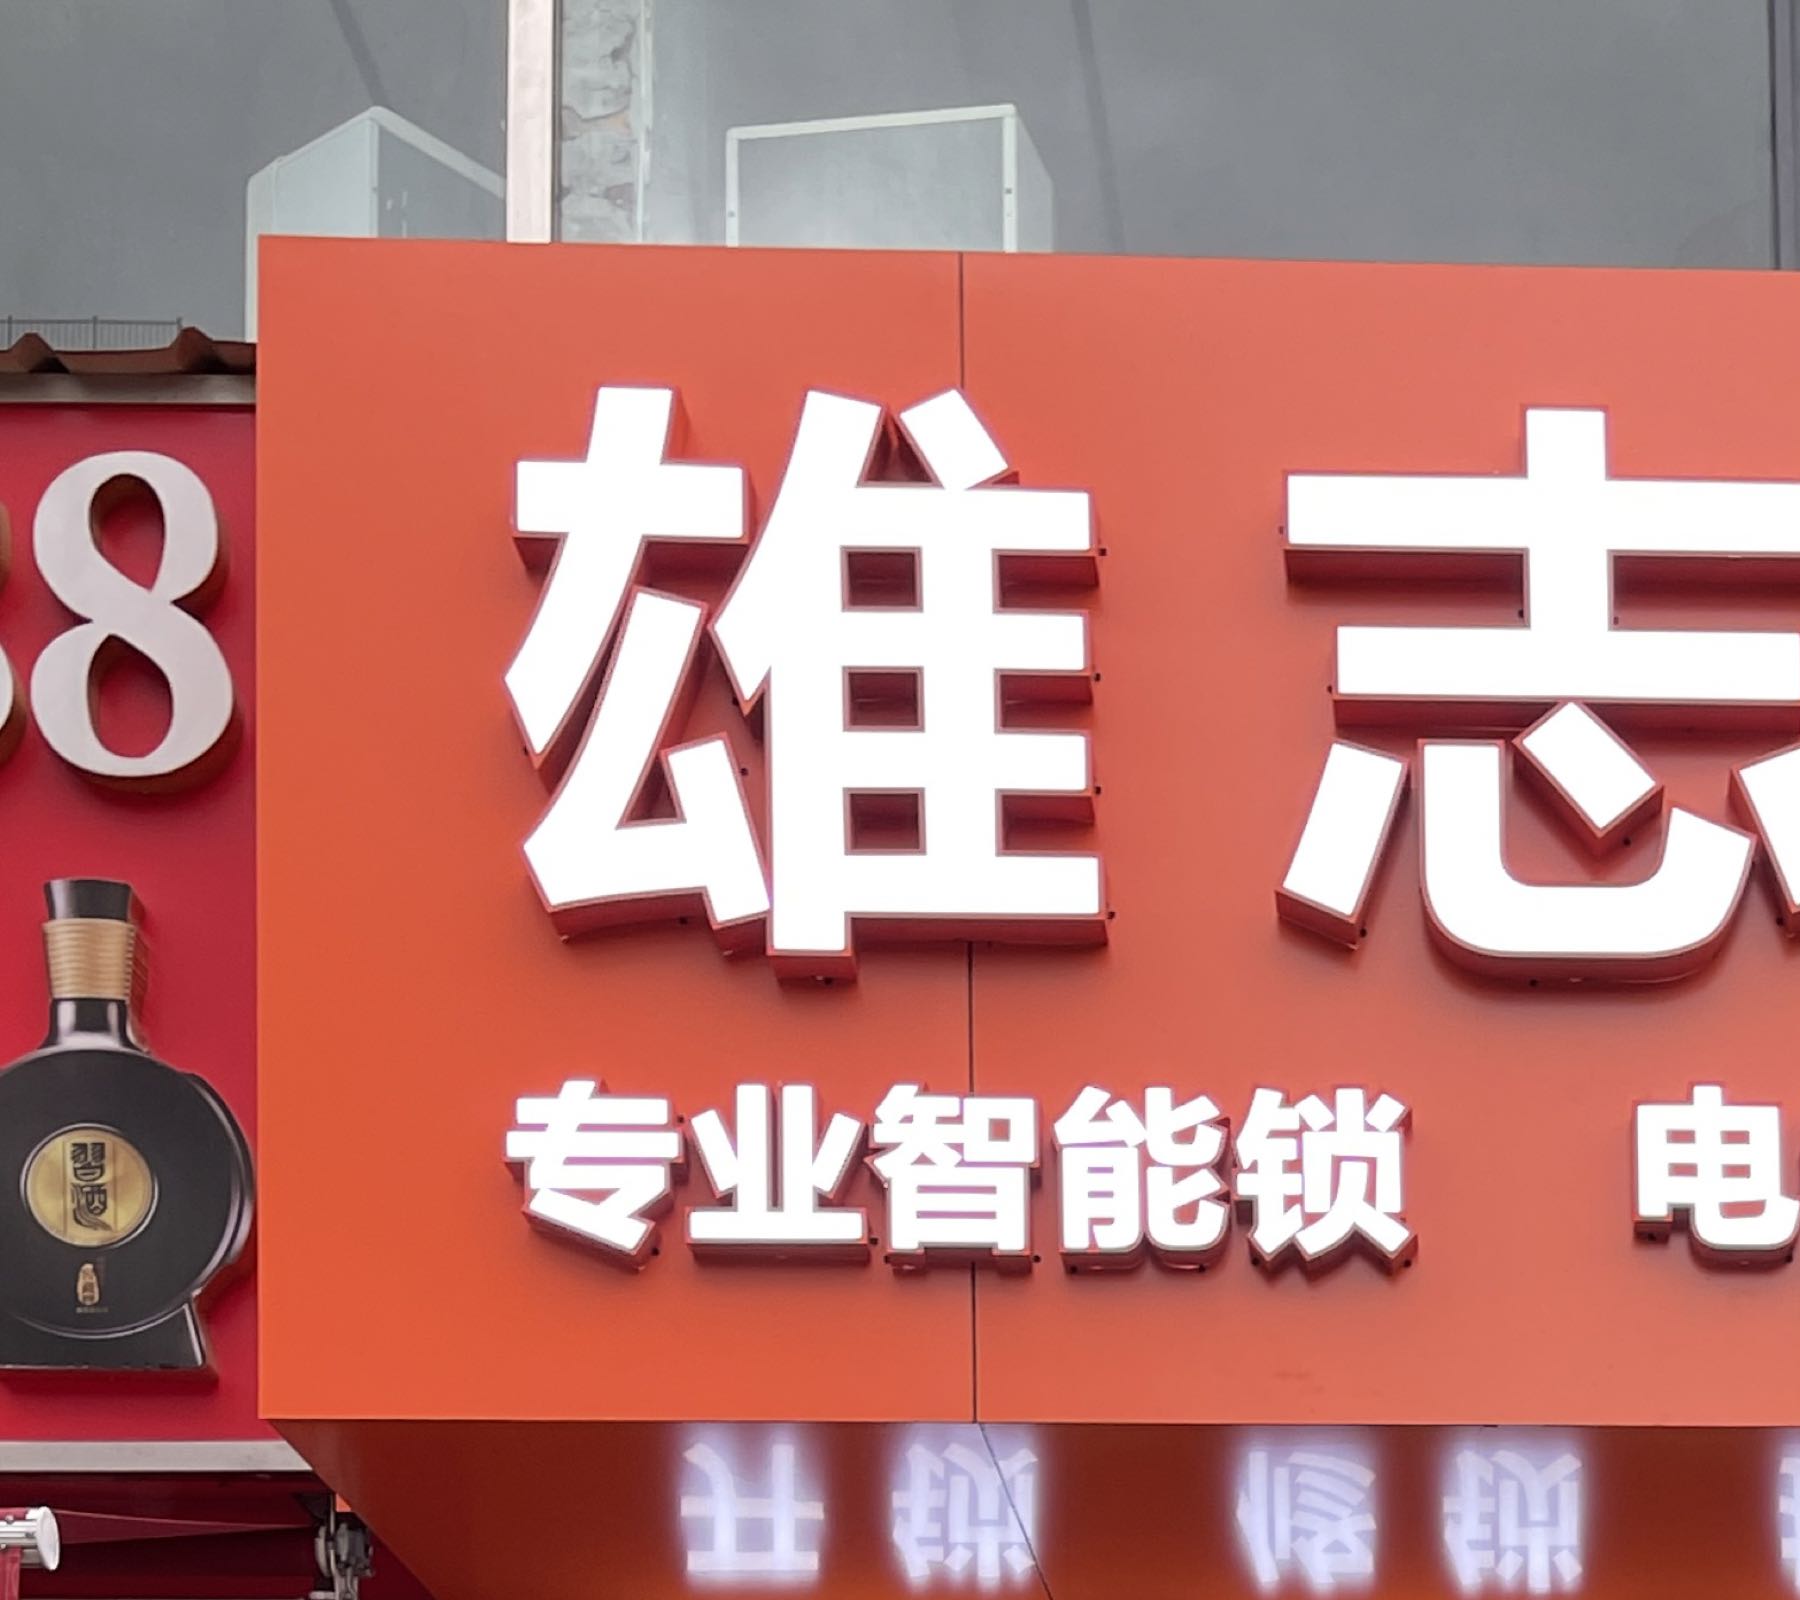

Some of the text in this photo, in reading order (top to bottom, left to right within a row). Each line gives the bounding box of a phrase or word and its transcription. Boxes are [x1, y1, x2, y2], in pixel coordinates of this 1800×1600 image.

[0, 450, 234, 778] 8
[504, 1080, 1410, 1262] 专业智能锁
